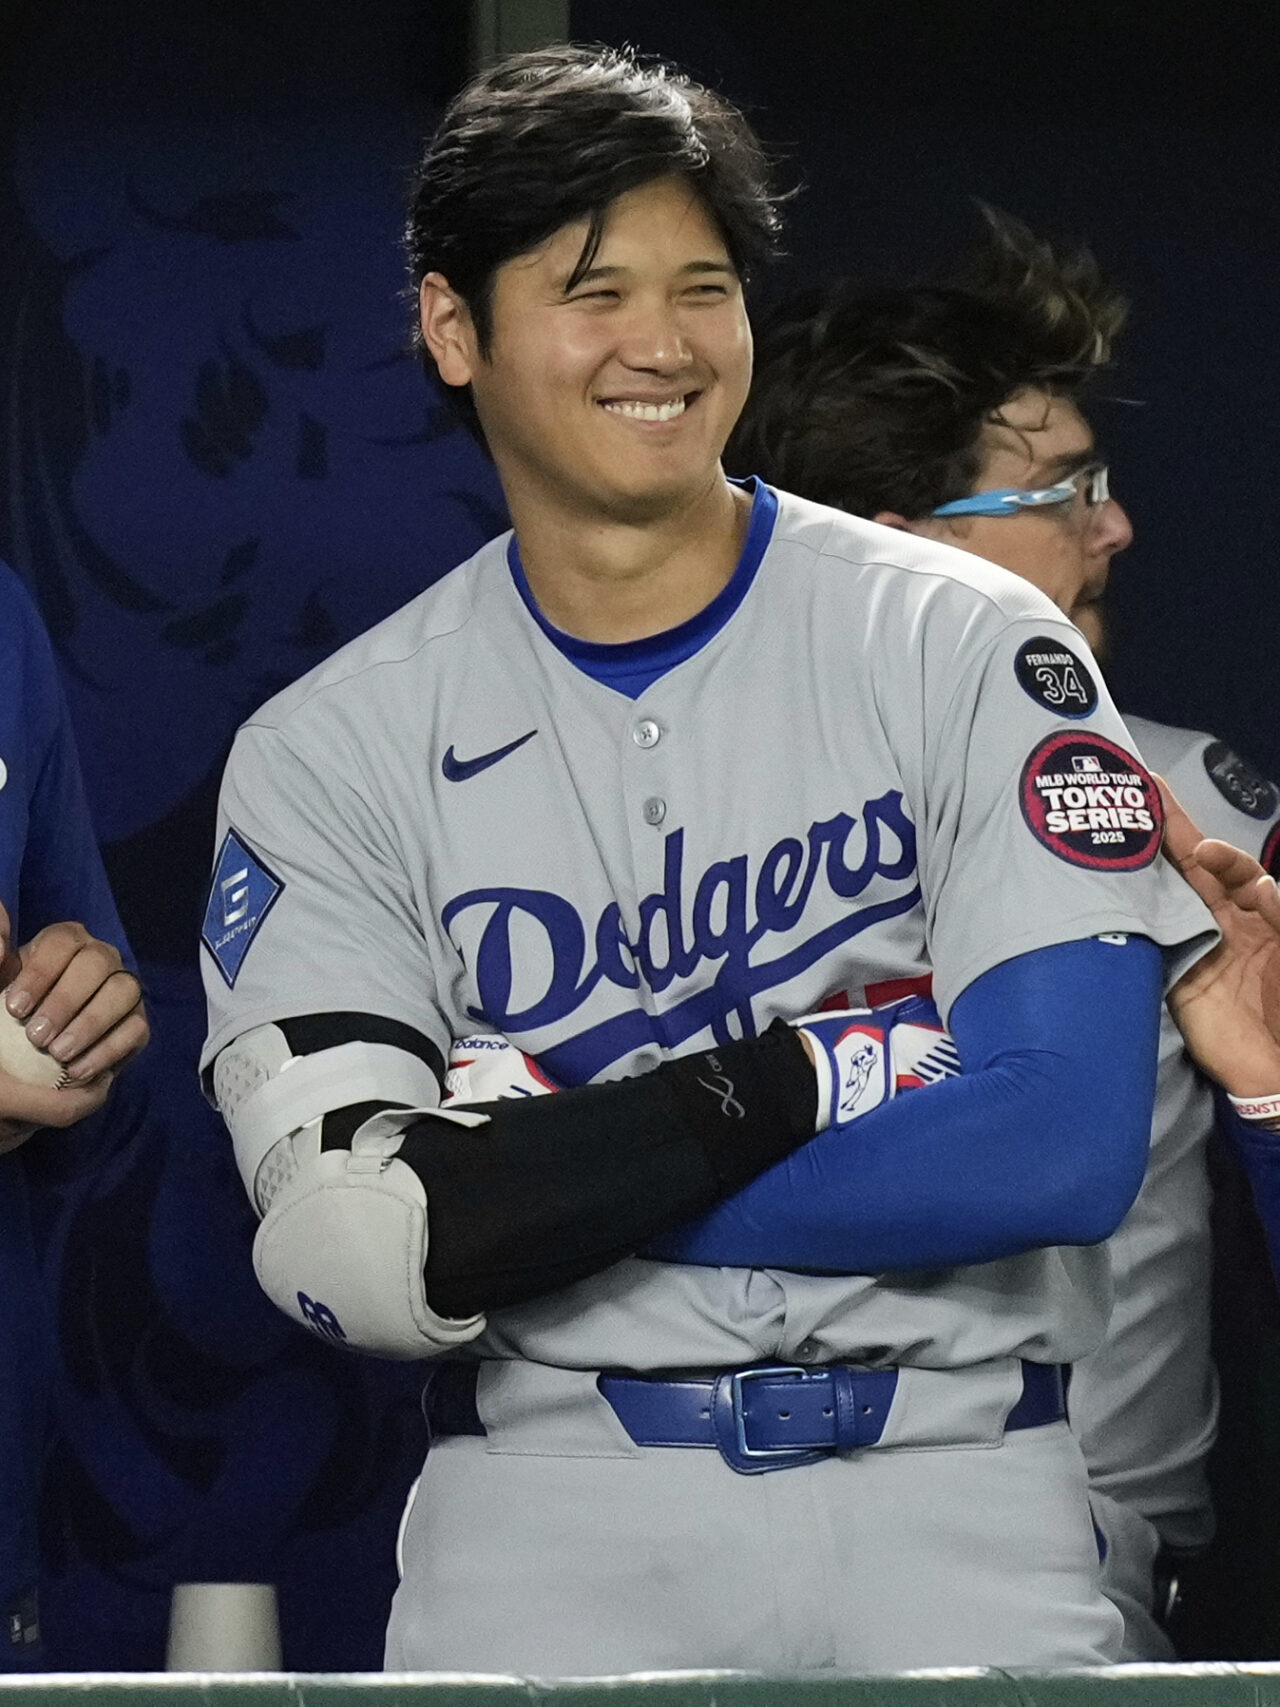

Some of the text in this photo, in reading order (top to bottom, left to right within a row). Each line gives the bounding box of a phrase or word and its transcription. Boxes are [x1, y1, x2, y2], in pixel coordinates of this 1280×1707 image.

[1025, 653, 1074, 668] FERNANDO
[1036, 667, 1088, 704] 34
[1035, 773, 1143, 788] MLB WORLD TOUR
[1041, 786, 1145, 810] TOKYO
[1045, 807, 1155, 834] SERIES
[1091, 831, 1126, 845] 2025
[441, 789, 918, 1046] Dodgers
[454, 1038, 510, 1051] balance
